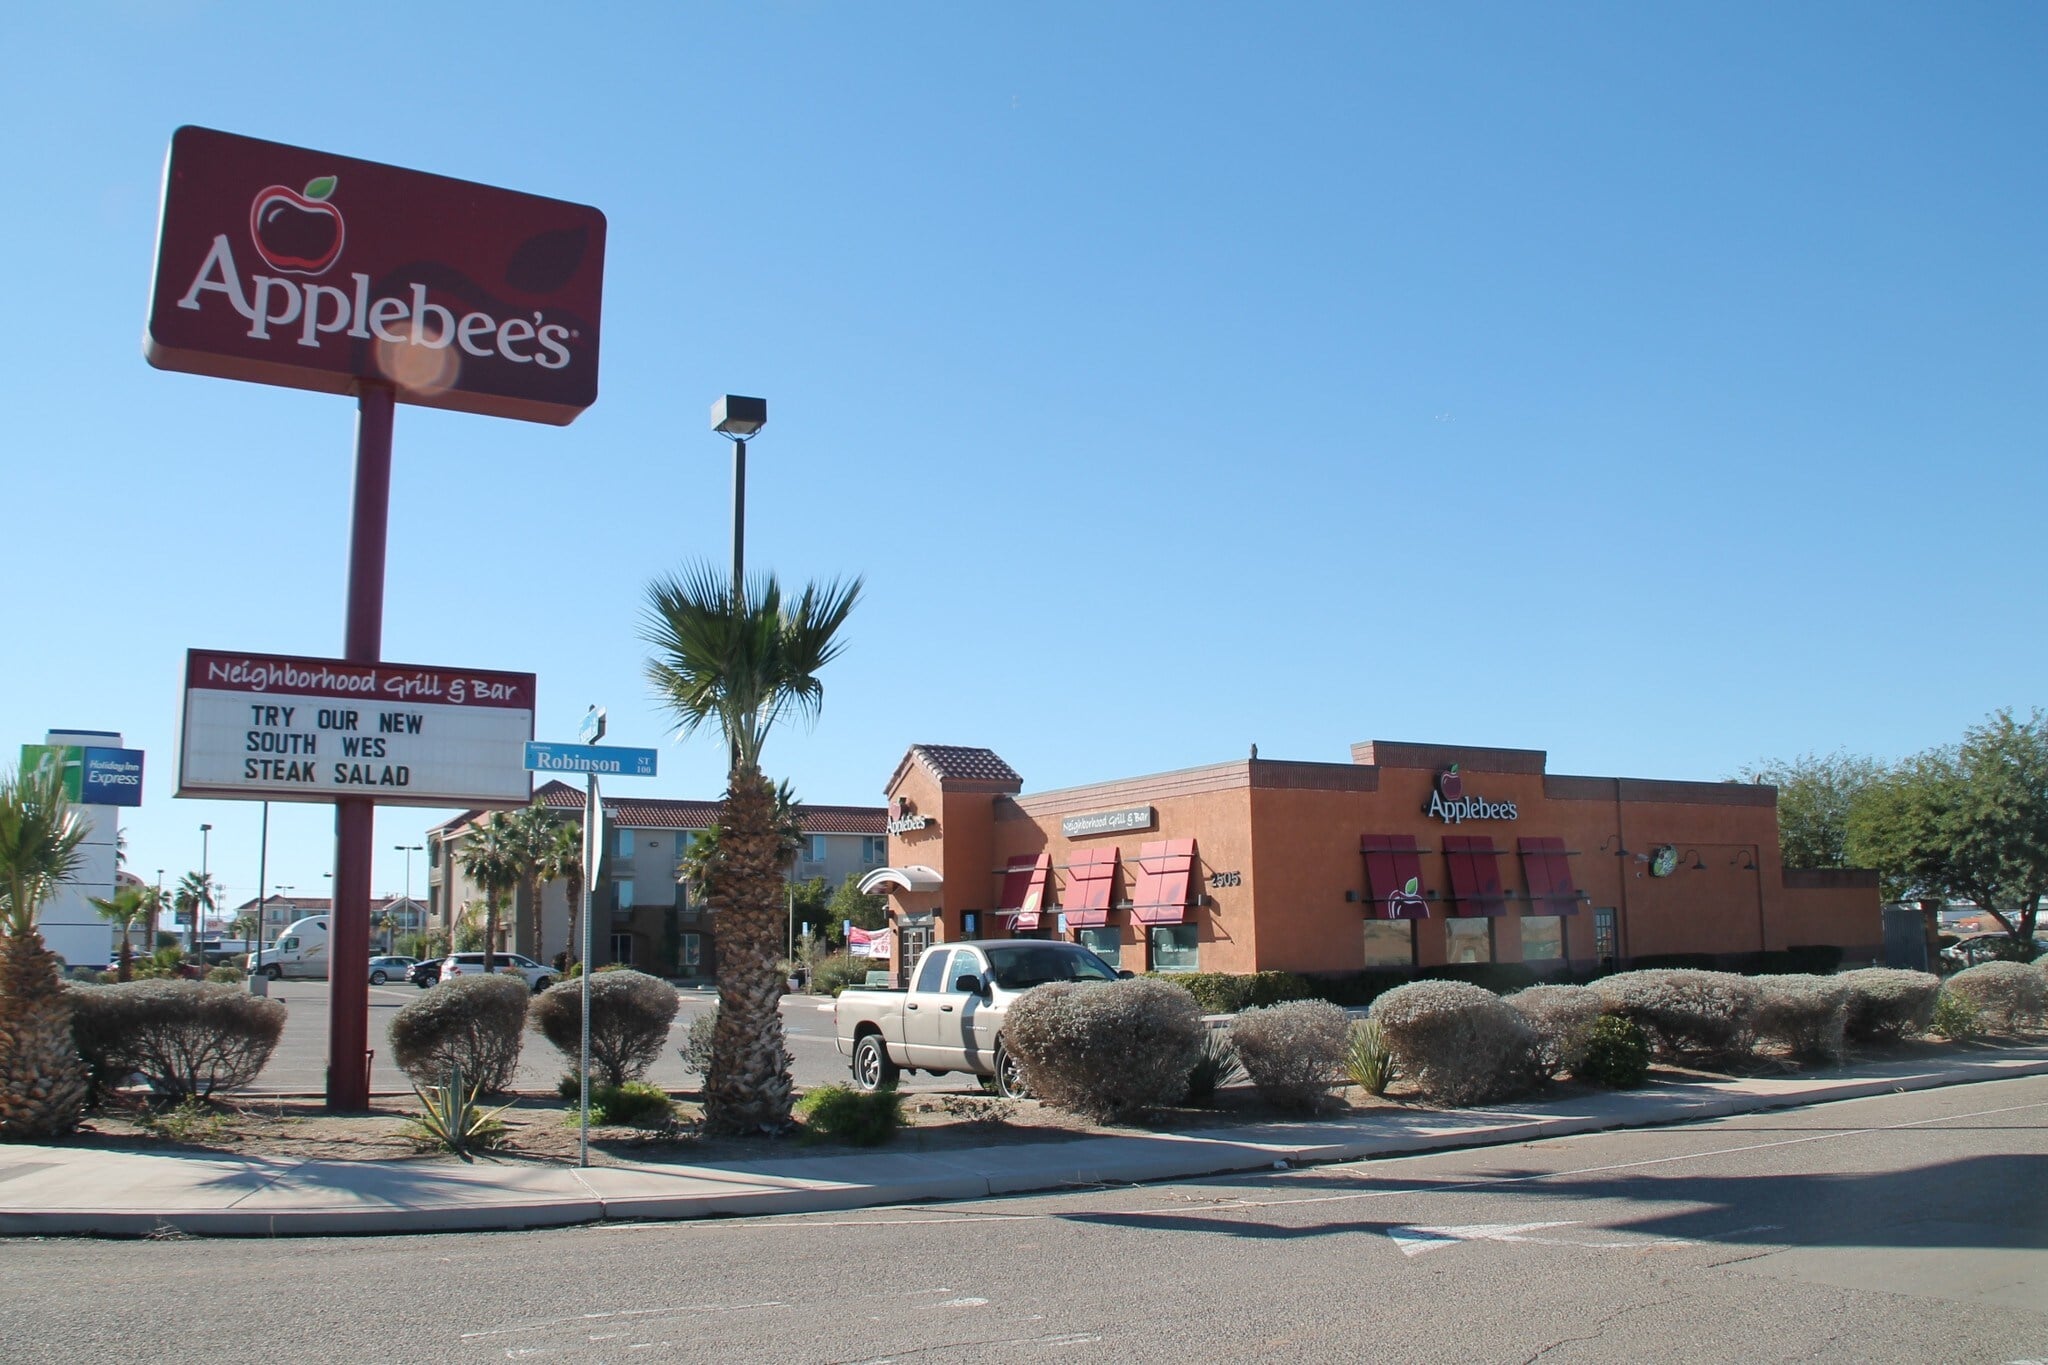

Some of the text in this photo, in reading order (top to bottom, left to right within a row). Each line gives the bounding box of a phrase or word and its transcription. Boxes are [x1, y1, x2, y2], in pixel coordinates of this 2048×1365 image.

[177, 234, 571, 370] Applebee's
[208, 660, 376, 692] Neighborhood
[383, 672, 442, 699] Grill
[471, 679, 518, 701] Bar
[251, 705, 423, 735] TRY OUR NEW
[246, 731, 386, 758] SOUTH WES
[90, 760, 139, 772] Holiday Inn
[244, 758, 410, 786] STEAK SALAD
[537, 752, 651, 773] Robinson ST
[637, 766, 652, 774] 100
[89, 771, 138, 786] Express
[1428, 789, 1518, 824] Applebee's
[1063, 815, 1107, 834] Neighborhood
[1109, 813, 1126, 828] Grill
[1134, 812, 1149, 823] Bar
[1212, 871, 1240, 887] 2505
